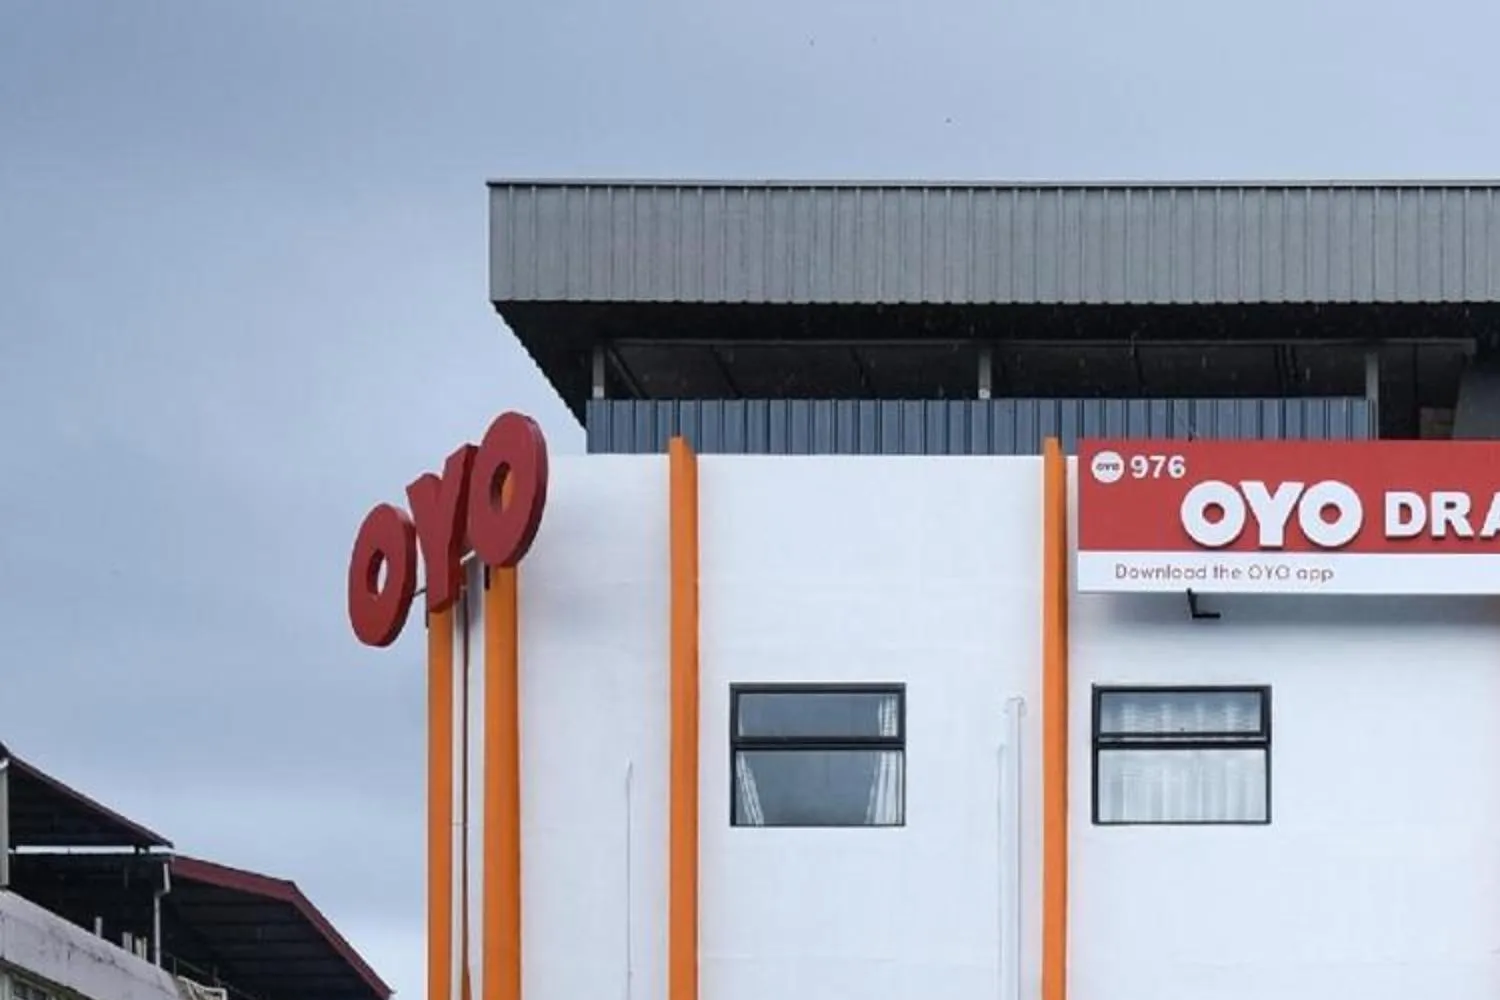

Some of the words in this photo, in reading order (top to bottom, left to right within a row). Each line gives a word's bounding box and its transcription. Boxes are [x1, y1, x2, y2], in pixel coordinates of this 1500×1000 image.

[1130, 454, 1187, 479] 976
[349, 411, 548, 647] OYO
[1181, 480, 1363, 549] OYO
[1115, 563, 1206, 580] Download
[1213, 563, 1242, 580] the
[1248, 564, 1291, 580] OYO
[1296, 567, 1334, 583] app
